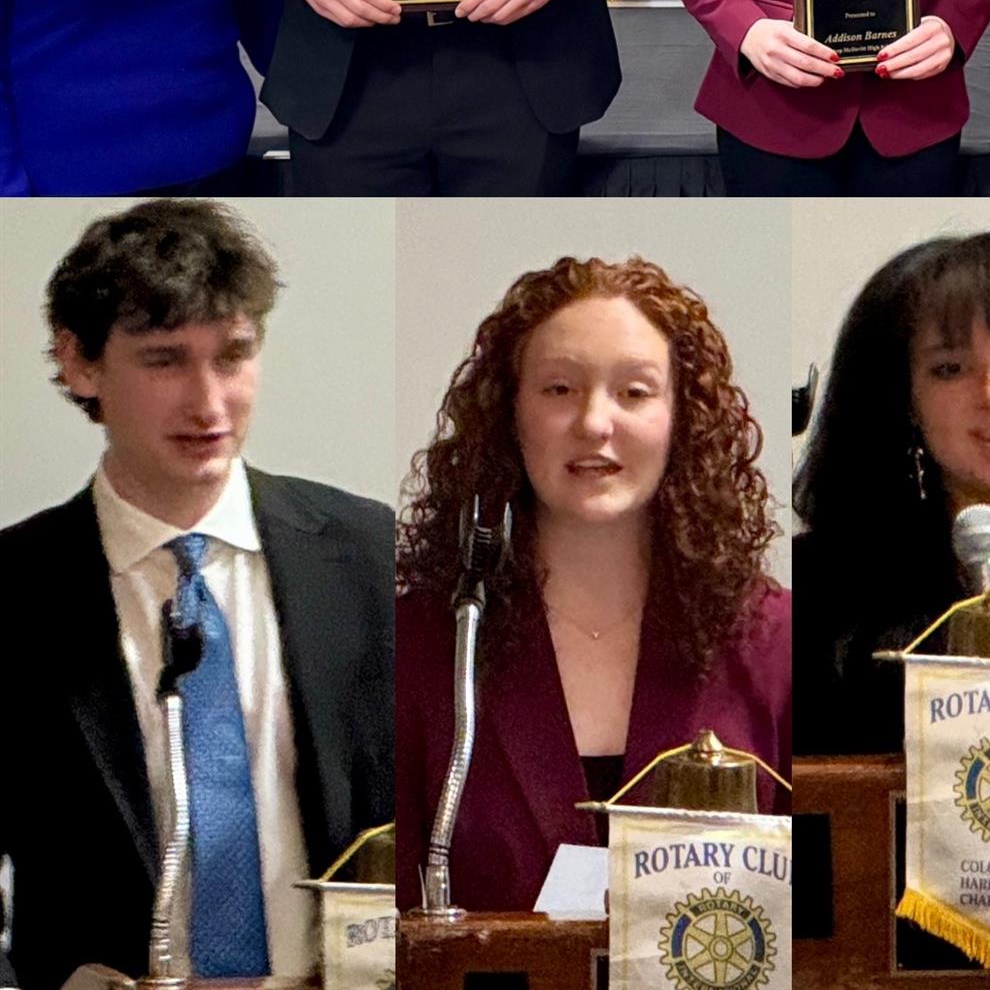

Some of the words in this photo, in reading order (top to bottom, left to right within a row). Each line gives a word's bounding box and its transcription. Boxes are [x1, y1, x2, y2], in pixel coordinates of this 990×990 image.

[824, 33, 862, 43] Addison
[865, 31, 897, 40] Barnes
[634, 842, 735, 880] ROTARY
[742, 844, 792, 886] CLU
[713, 870, 731, 885] OF
